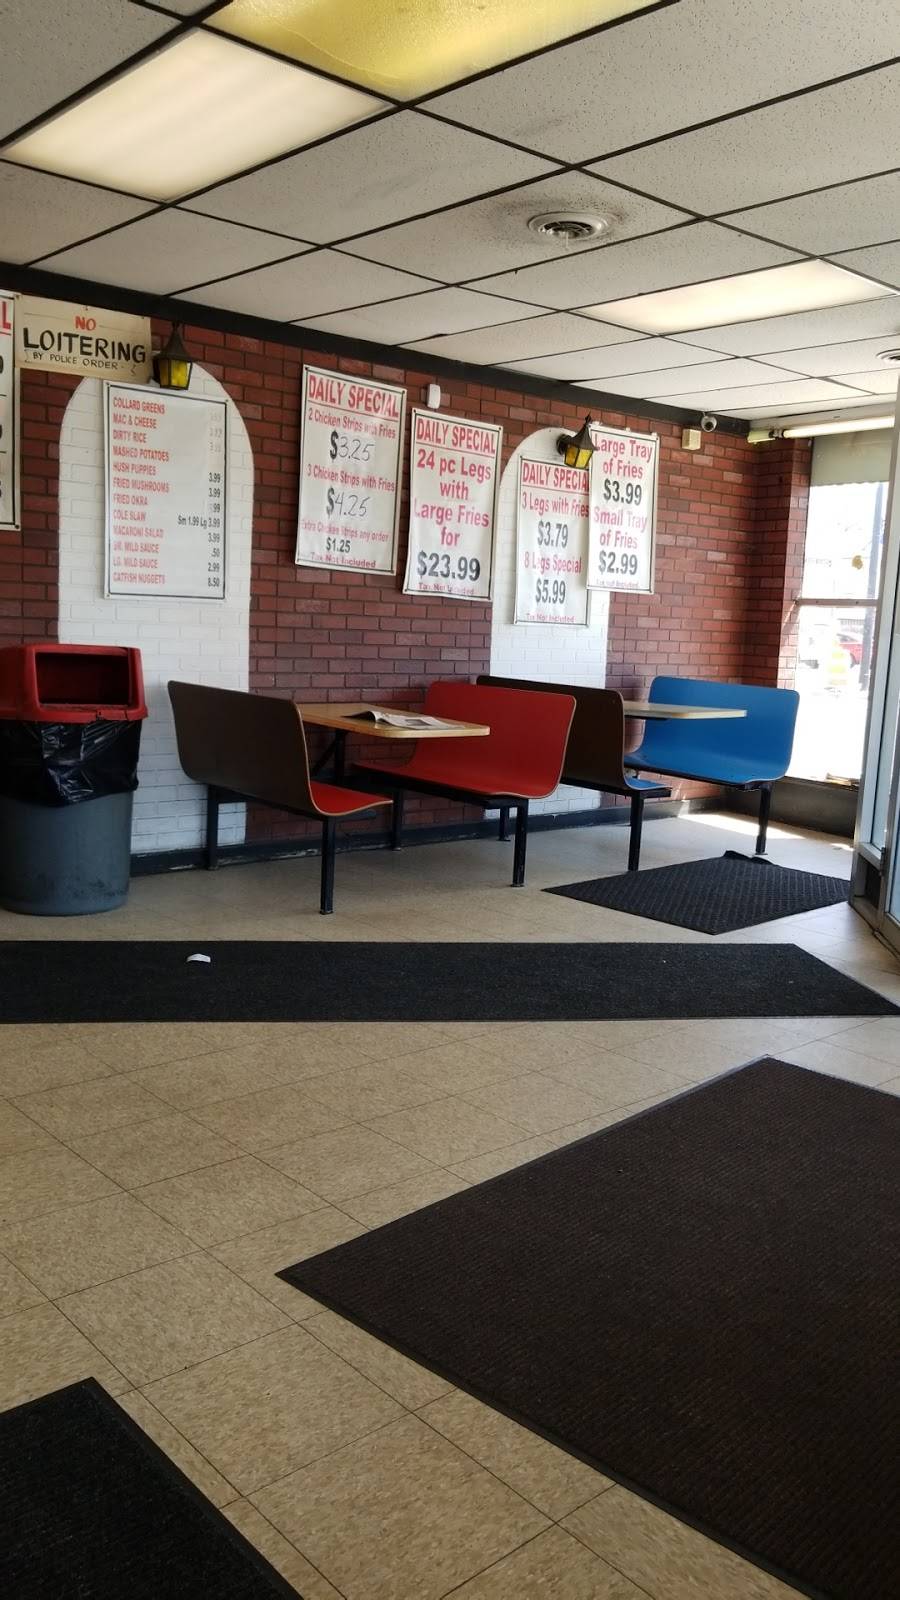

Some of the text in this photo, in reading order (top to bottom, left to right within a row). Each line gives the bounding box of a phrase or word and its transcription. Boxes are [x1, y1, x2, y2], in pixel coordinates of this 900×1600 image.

[74, 315, 97, 331] NO
[23, 327, 147, 364] LOITERING
[33, 351, 119, 370] BY POLICE ORDER
[112, 396, 165, 414] COLLARD GREENS
[308, 374, 399, 418] DAILY SPECIAL
[112, 412, 157, 429] MAC & CHEESE
[308, 407, 313, 421] 2
[314, 408, 341, 428] Chicken
[342, 415, 363, 432] Strips
[378, 424, 396, 439] Fries
[112, 429, 147, 444] DIRTY RICE
[329, 429, 375, 463] $3.25
[416, 417, 496, 454] DAILY SPECIAL
[112, 445, 170, 462] MASHED POTATOES
[594, 433, 653, 463] Large Tray
[112, 462, 156, 476] HUSH PUPPIES
[417, 448, 492, 484] 24 pc Legs
[522, 462, 589, 490] DAILY SPECIA
[603, 458, 644, 479] of Fries
[112, 476, 169, 493] FRIED MUSHROOMS
[208, 472, 221, 484] 3.99
[307, 463, 395, 492] 3 Chicken Strips with Fries
[112, 493, 148, 506] FRIED OKRA
[208, 487, 221, 498] 3.99
[440, 479, 469, 500] with
[603, 478, 642, 506] $3.99
[326, 486, 370, 519] $4.25
[414, 498, 490, 527] Large Fries
[522, 491, 527, 509] 3
[529, 492, 549, 515] Legs
[551, 496, 569, 511] with
[112, 509, 146, 521] COLE SLAW
[188, 516, 199, 526] 1.99
[208, 518, 220, 528] 3.99
[594, 506, 648, 533] Small Tray
[440, 526, 461, 546] for
[537, 519, 568, 548] $3.79
[599, 529, 638, 549] of Fries
[139, 543, 159, 553] SAUCE
[326, 537, 351, 553] $1.25
[138, 558, 158, 568] SAUCE
[341, 556, 376, 568] Included
[417, 549, 481, 582] $23.99
[524, 551, 529, 568] 8
[552, 554, 582, 574] Special
[598, 549, 638, 575] $2.99
[535, 578, 566, 606] $5.99
